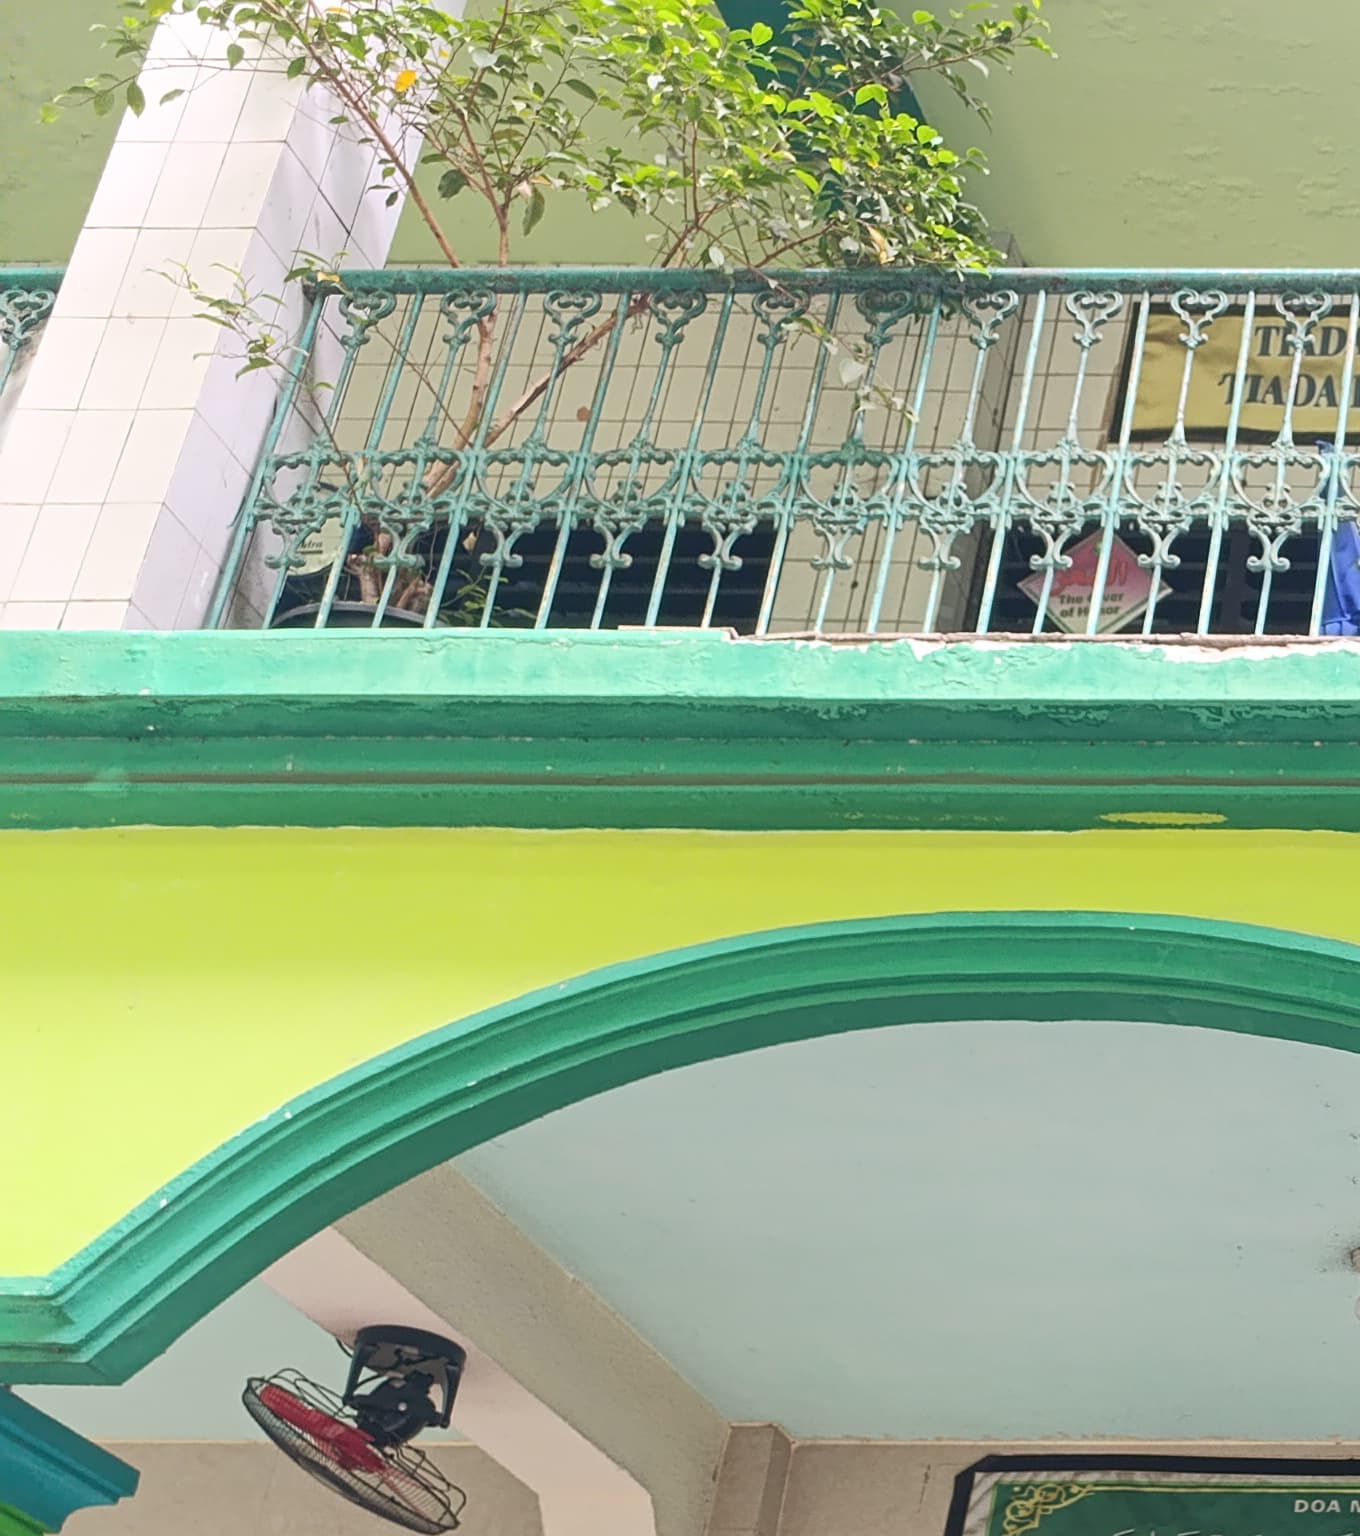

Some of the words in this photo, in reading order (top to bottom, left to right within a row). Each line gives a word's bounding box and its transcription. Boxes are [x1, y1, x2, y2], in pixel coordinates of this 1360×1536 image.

[1218, 373, 1340, 408] TIADA
[1060, 595, 1084, 605] The
[1060, 607, 1075, 618] of
[1294, 1499, 1341, 1514] DOA
